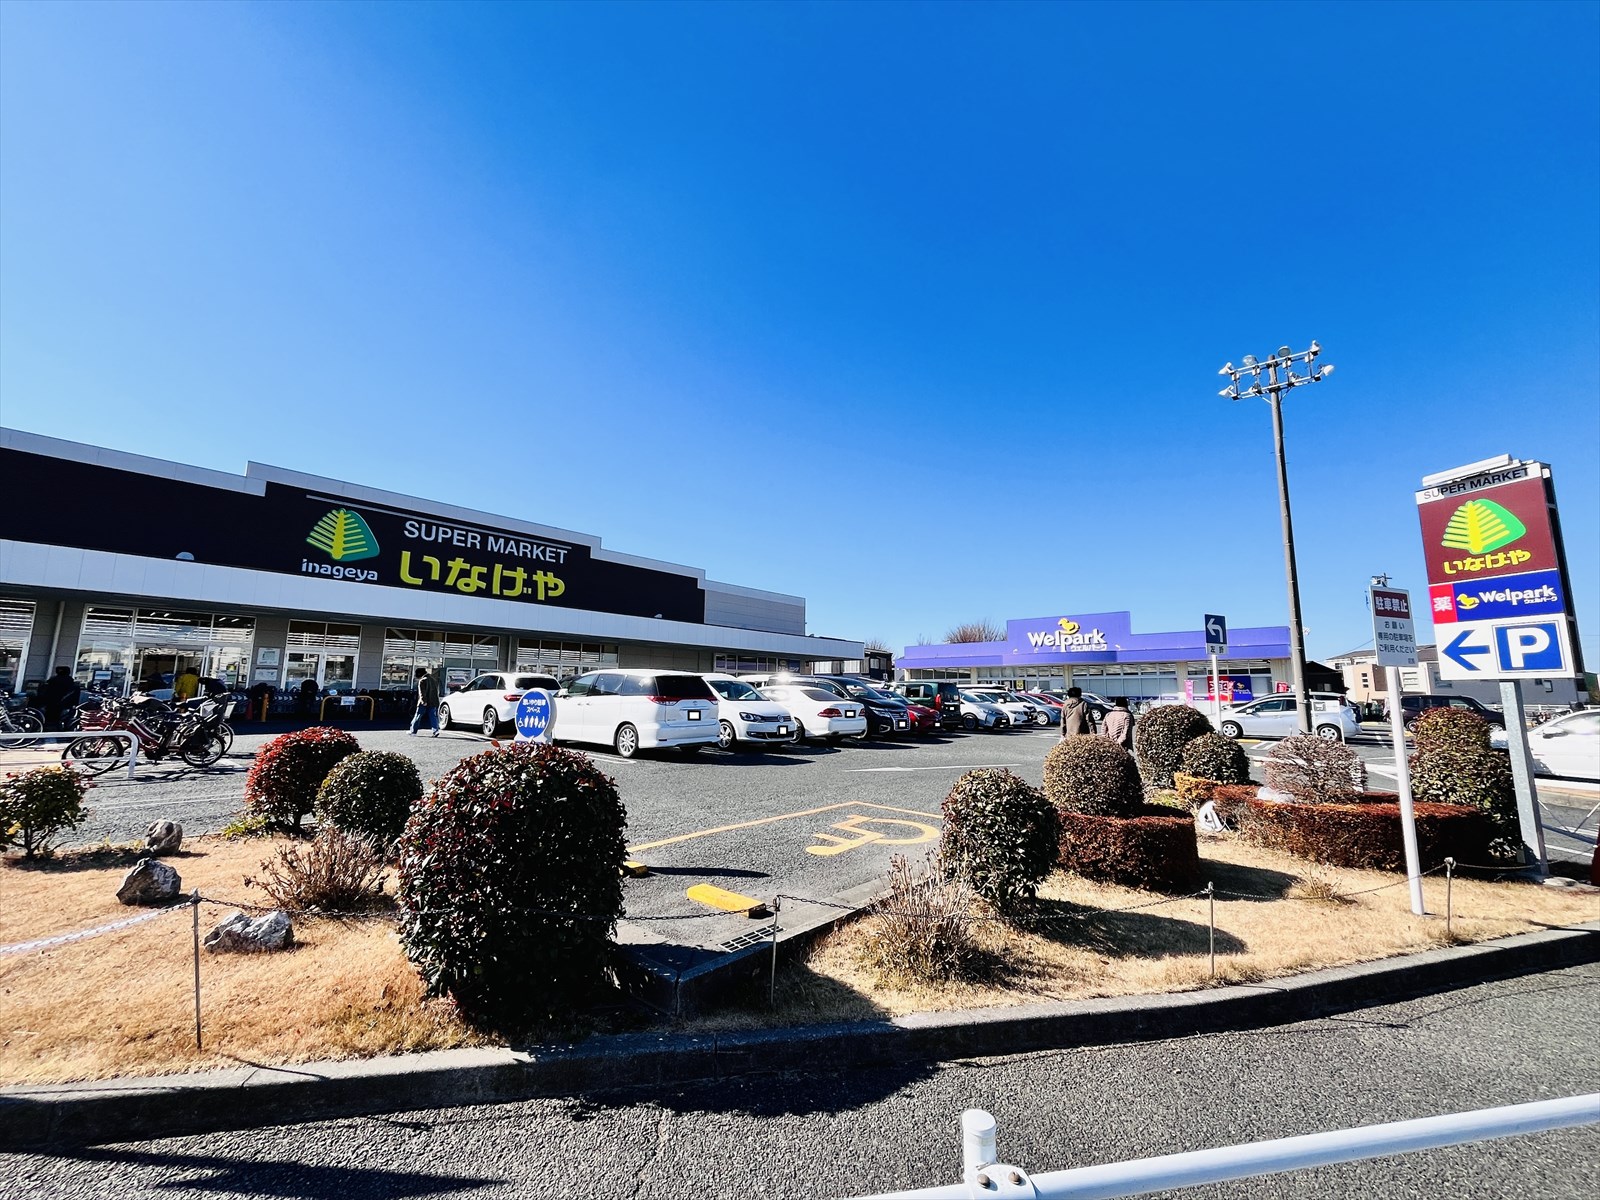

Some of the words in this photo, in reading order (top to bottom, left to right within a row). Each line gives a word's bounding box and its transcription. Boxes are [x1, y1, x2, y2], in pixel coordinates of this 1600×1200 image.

[1424, 483, 1466, 500] SUPER
[1470, 467, 1528, 489] MARKET
[403, 520, 481, 549] SUPER
[487, 536, 568, 564] MARKET
[301, 558, 378, 581] inageya
[400, 550, 566, 600] いなげや
[1375, 596, 1409, 612] 駐車禁止
[1433, 596, 1453, 612] 薬
[1479, 584, 1555, 605] Welpark
[1027, 628, 1105, 652] Welpark
[1379, 644, 1415, 654] ご利用ください
[1506, 627, 1550, 668] P
